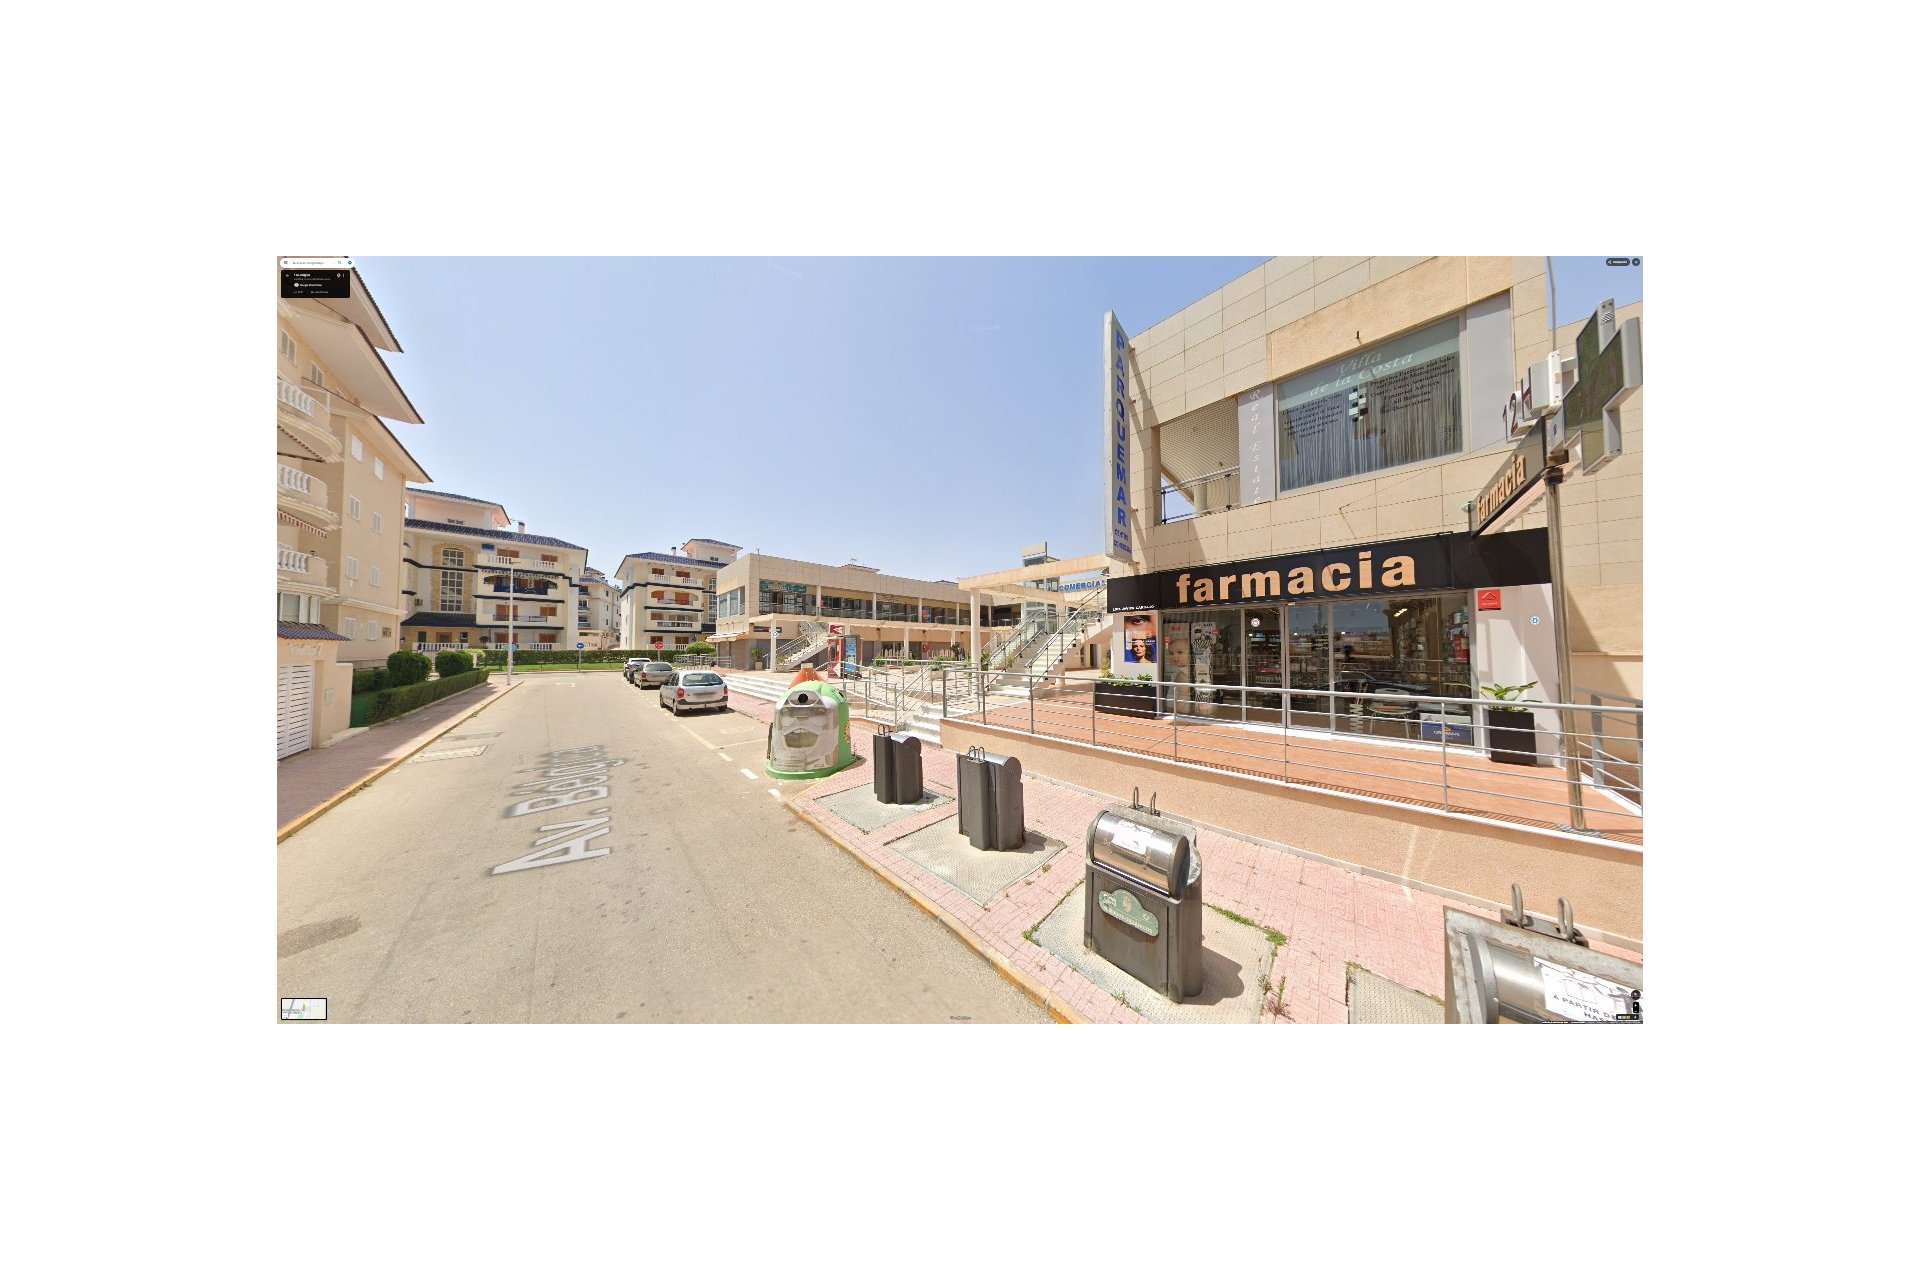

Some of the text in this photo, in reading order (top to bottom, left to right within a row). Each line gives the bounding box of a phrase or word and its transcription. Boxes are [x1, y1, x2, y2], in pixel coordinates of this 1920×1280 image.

[1340, 352, 1382, 374] Villa
[1359, 353, 1413, 380] Costa
[1115, 329, 1127, 527] PARQUEMAR
[1248, 389, 1262, 504] Real Estate
[1477, 454, 1526, 525] farmacia
[1176, 550, 1417, 604] farmacia
[1562, 997, 1600, 1015] PARTIR
